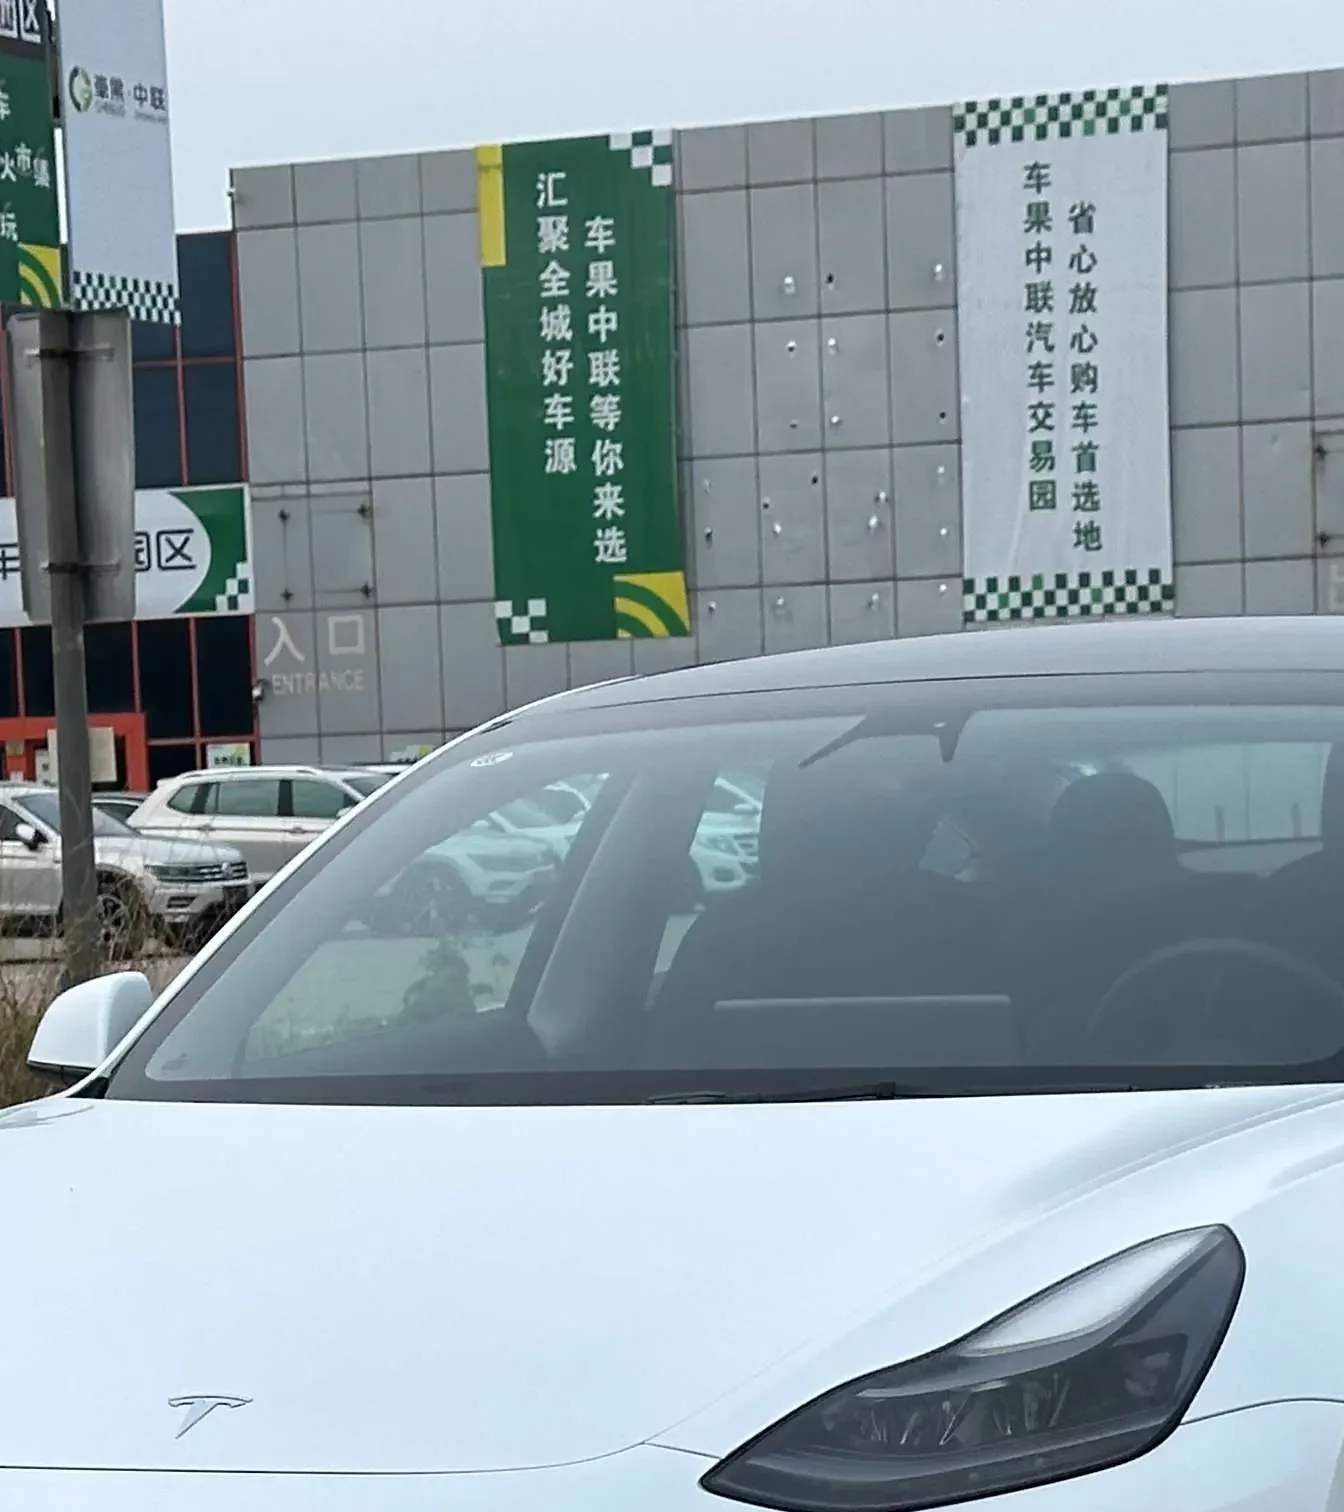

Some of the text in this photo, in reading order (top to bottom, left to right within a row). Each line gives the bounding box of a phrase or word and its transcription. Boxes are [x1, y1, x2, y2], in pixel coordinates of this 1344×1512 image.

[536, 172, 577, 474] 汇聚全城好车源
[584, 216, 627, 563] 车果中联等你来选
[1023, 161, 1057, 511] 车果中联汽车交易园
[1068, 200, 1102, 552] 省心放心购车首选地
[264, 615, 365, 666] 入口
[272, 669, 364, 695] ENTRANCE
